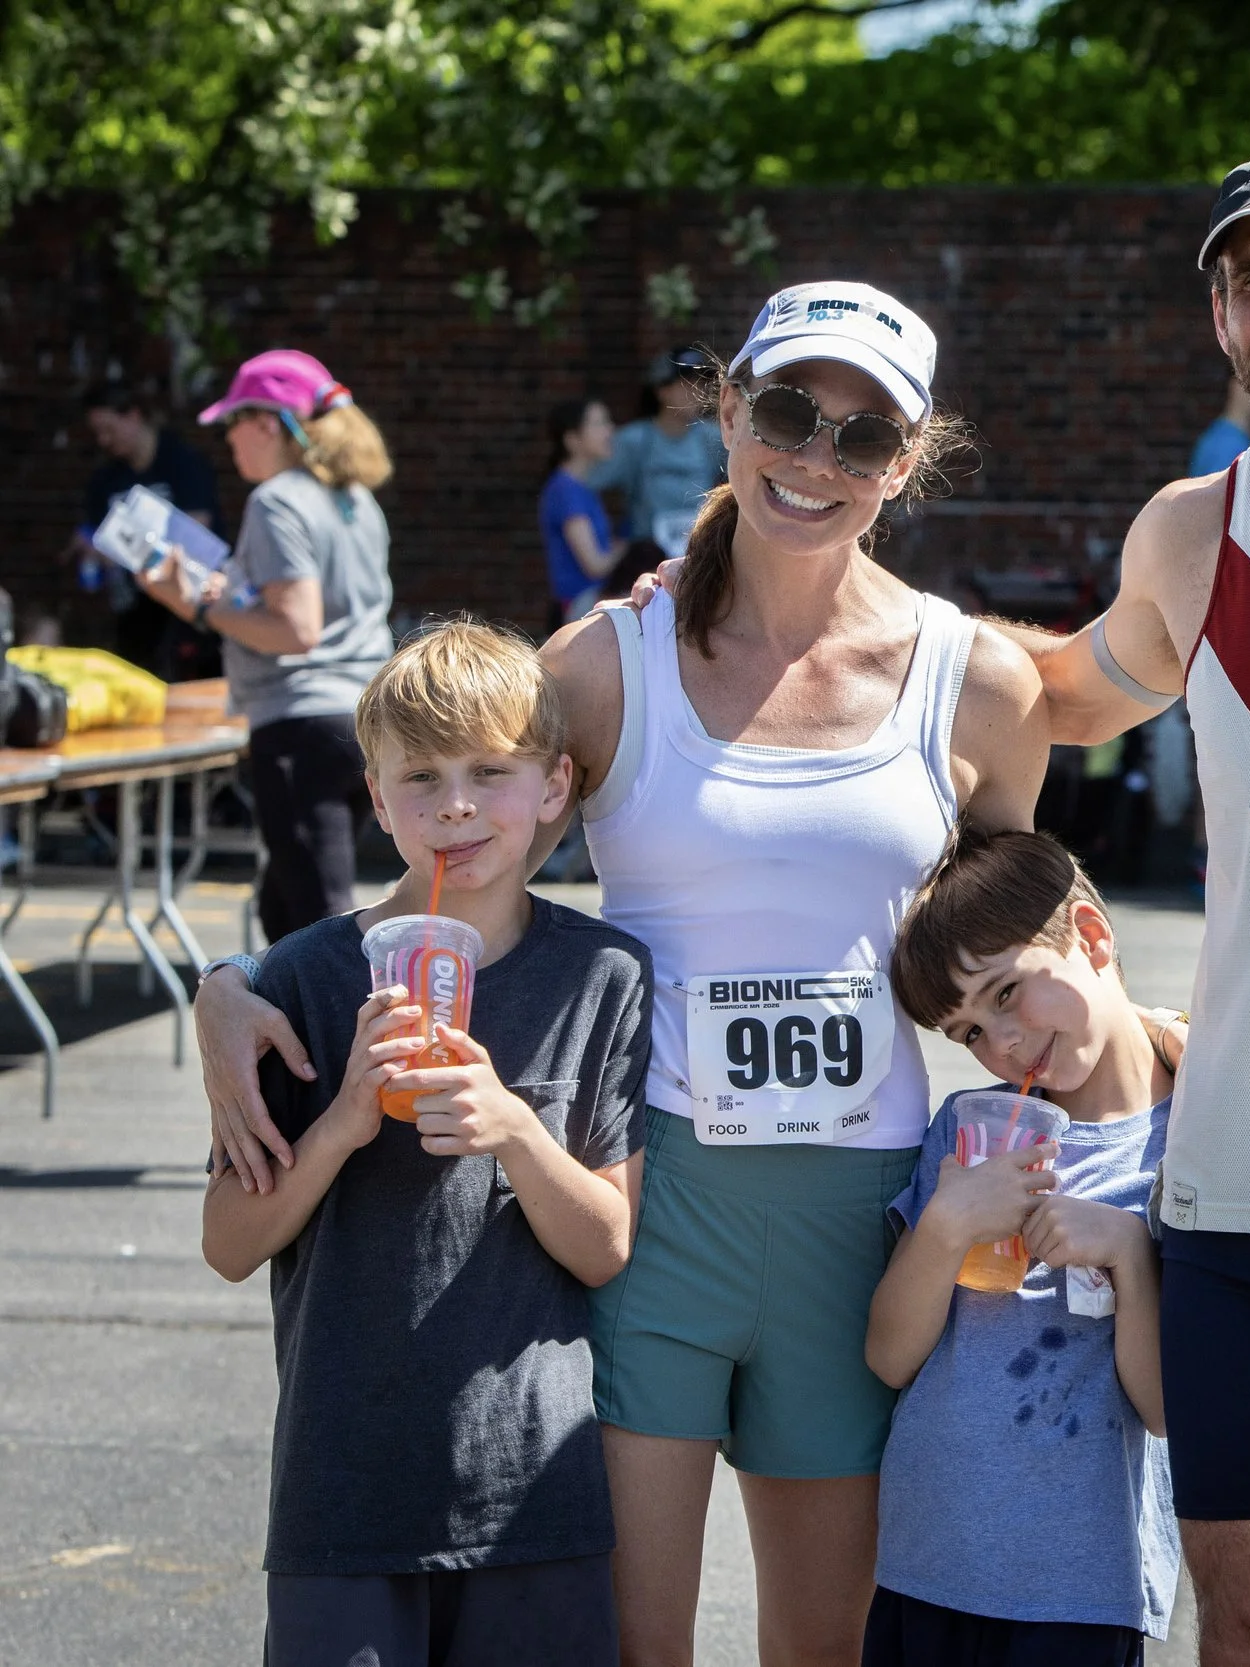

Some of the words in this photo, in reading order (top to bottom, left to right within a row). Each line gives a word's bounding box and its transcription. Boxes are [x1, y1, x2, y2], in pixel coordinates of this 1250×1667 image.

[806, 310, 844, 323] 70.3
[710, 977, 849, 1003] BIONIC
[726, 1014, 863, 1090] 969
[708, 1124, 748, 1135] FOOD
[777, 1121, 821, 1133] DRINK
[842, 1110, 870, 1128] DRINK
